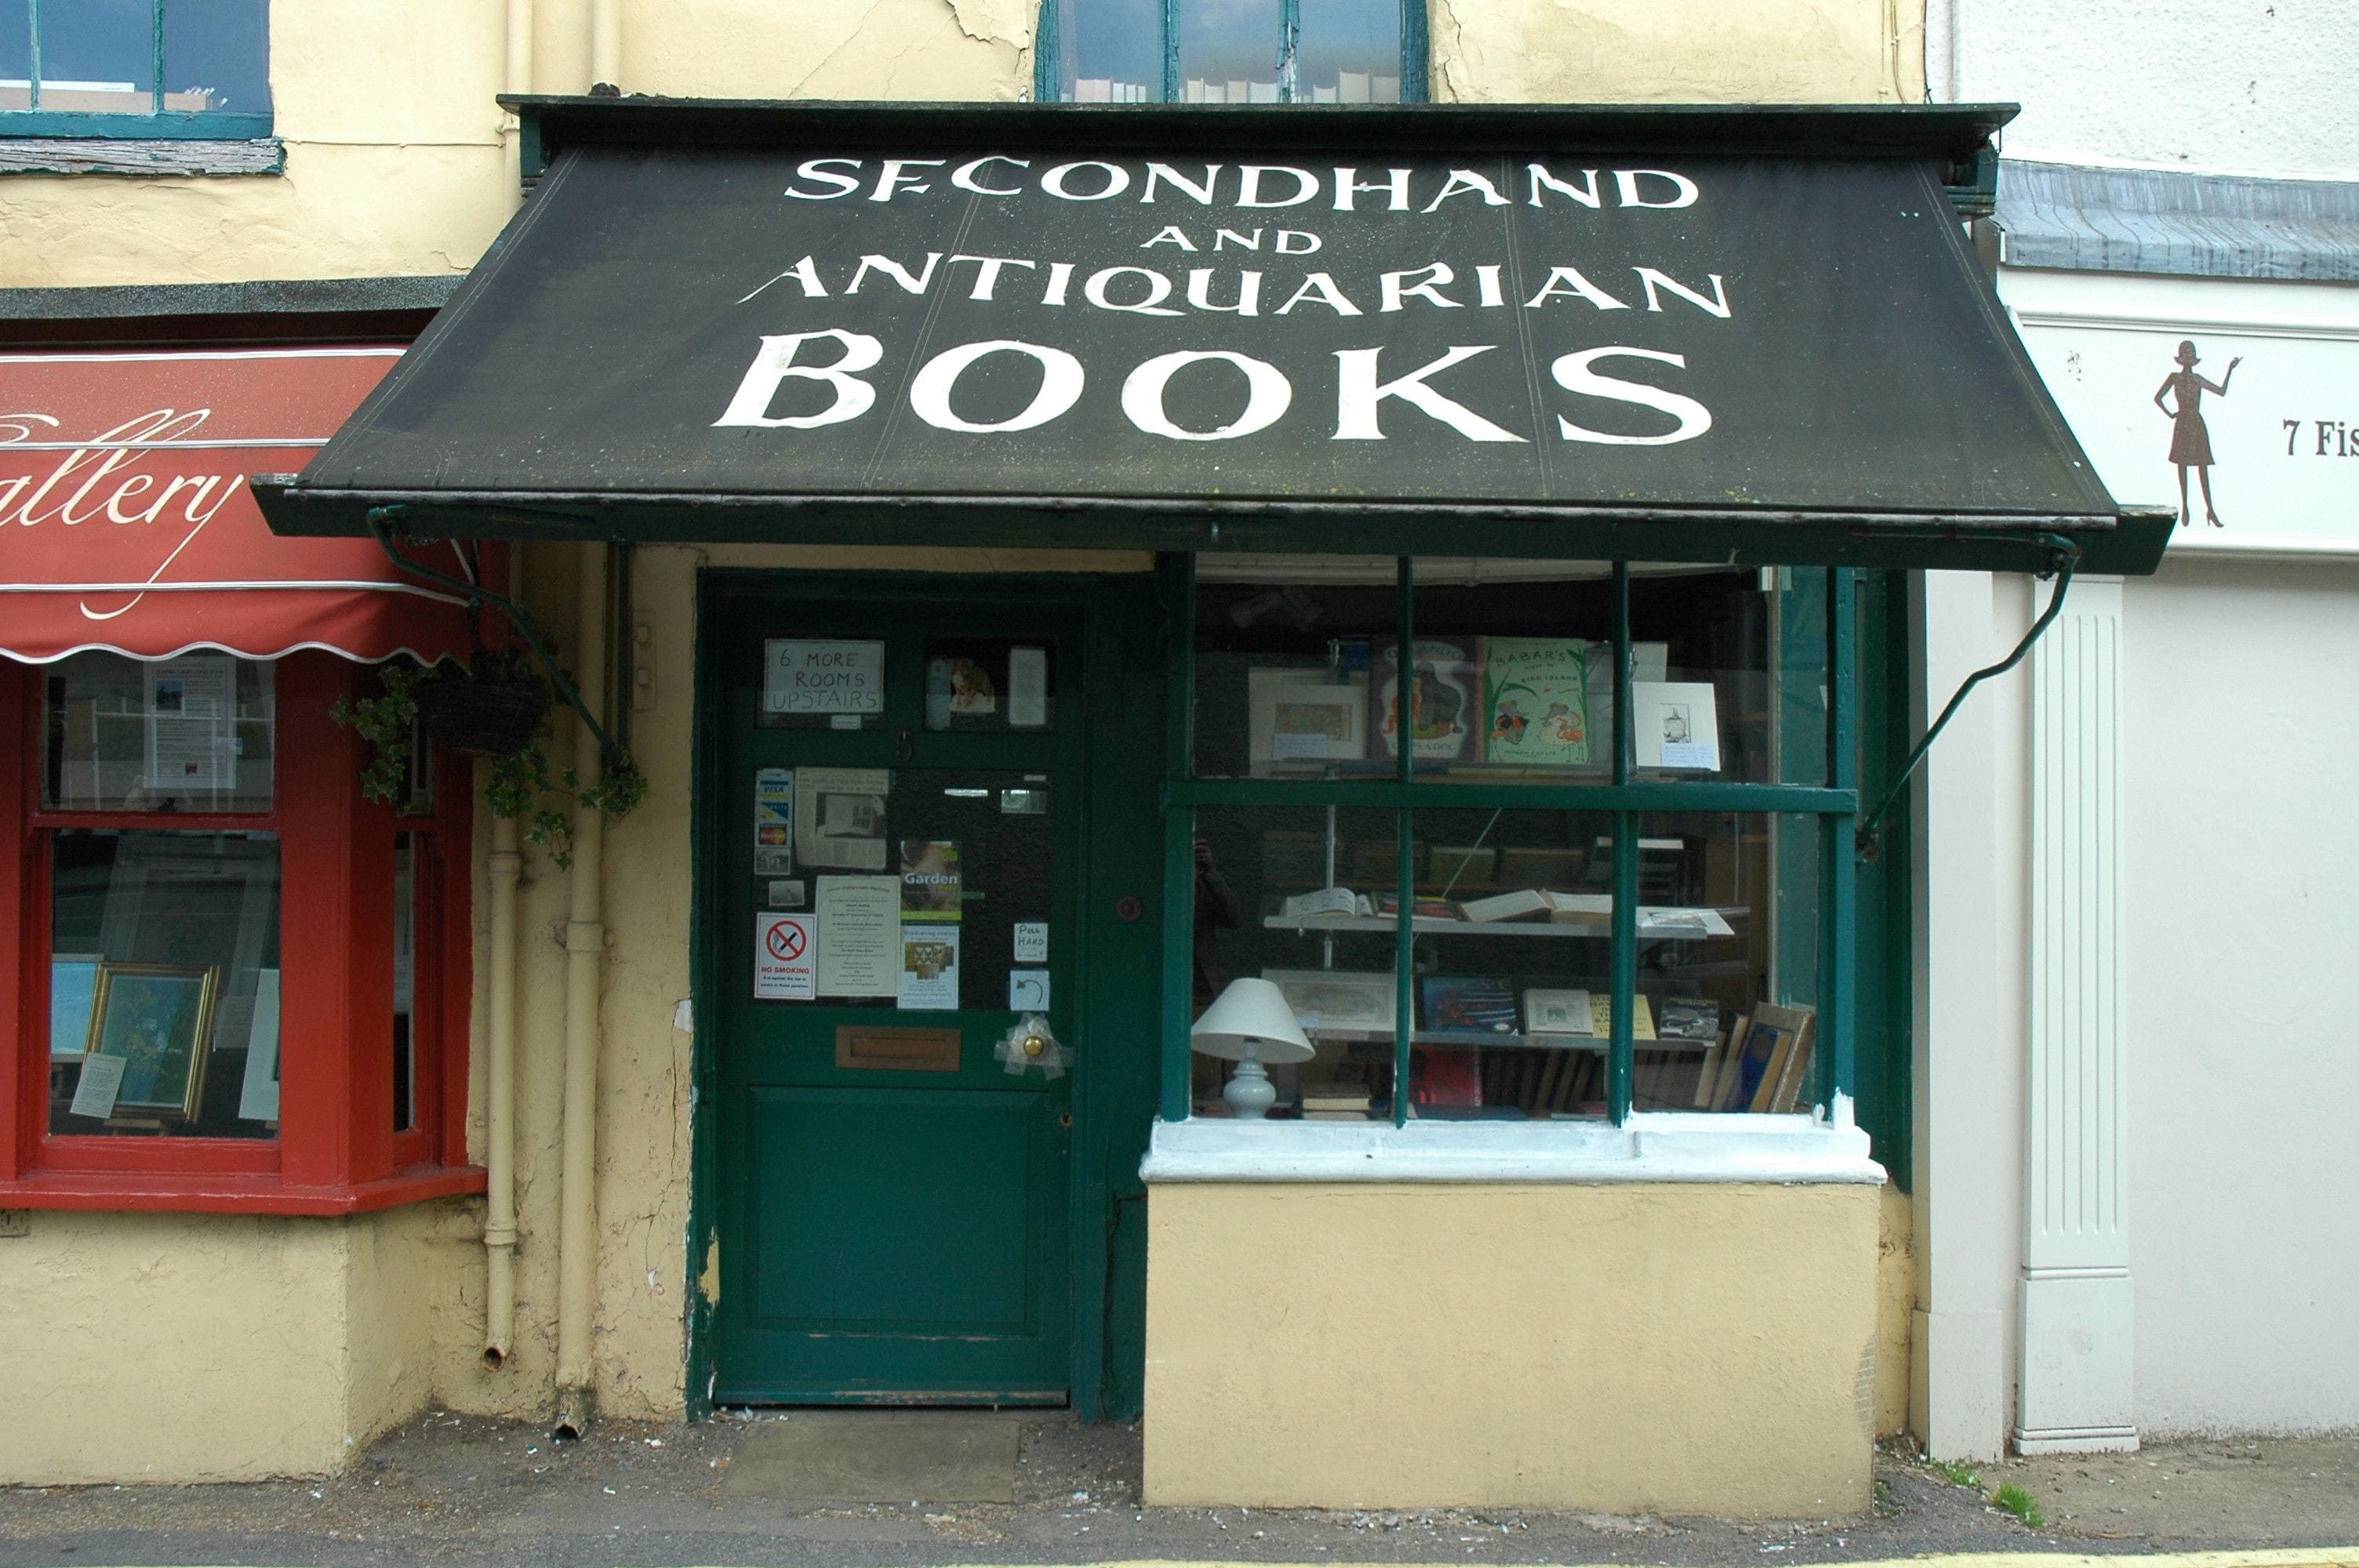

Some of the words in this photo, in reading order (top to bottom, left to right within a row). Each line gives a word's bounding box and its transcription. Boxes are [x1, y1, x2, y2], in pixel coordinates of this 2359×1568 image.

[783, 156, 1699, 213] SECONDHAND
[1140, 225, 1323, 255] AND
[736, 252, 1732, 318] ANTIQUARIAN
[710, 328, 1713, 445] BOOKS
[2283, 419, 2300, 456] 7
[780, 648, 791, 666] 6
[806, 652, 859, 667] MORE
[1495, 650, 1566, 667] BABAR'S
[795, 671, 865, 688] ROOMS
[772, 690, 878, 710] UPSTAIRS
[764, 785, 783, 793] VISA
[904, 873, 958, 884] Garden
[1017, 936, 1045, 946] HARD
